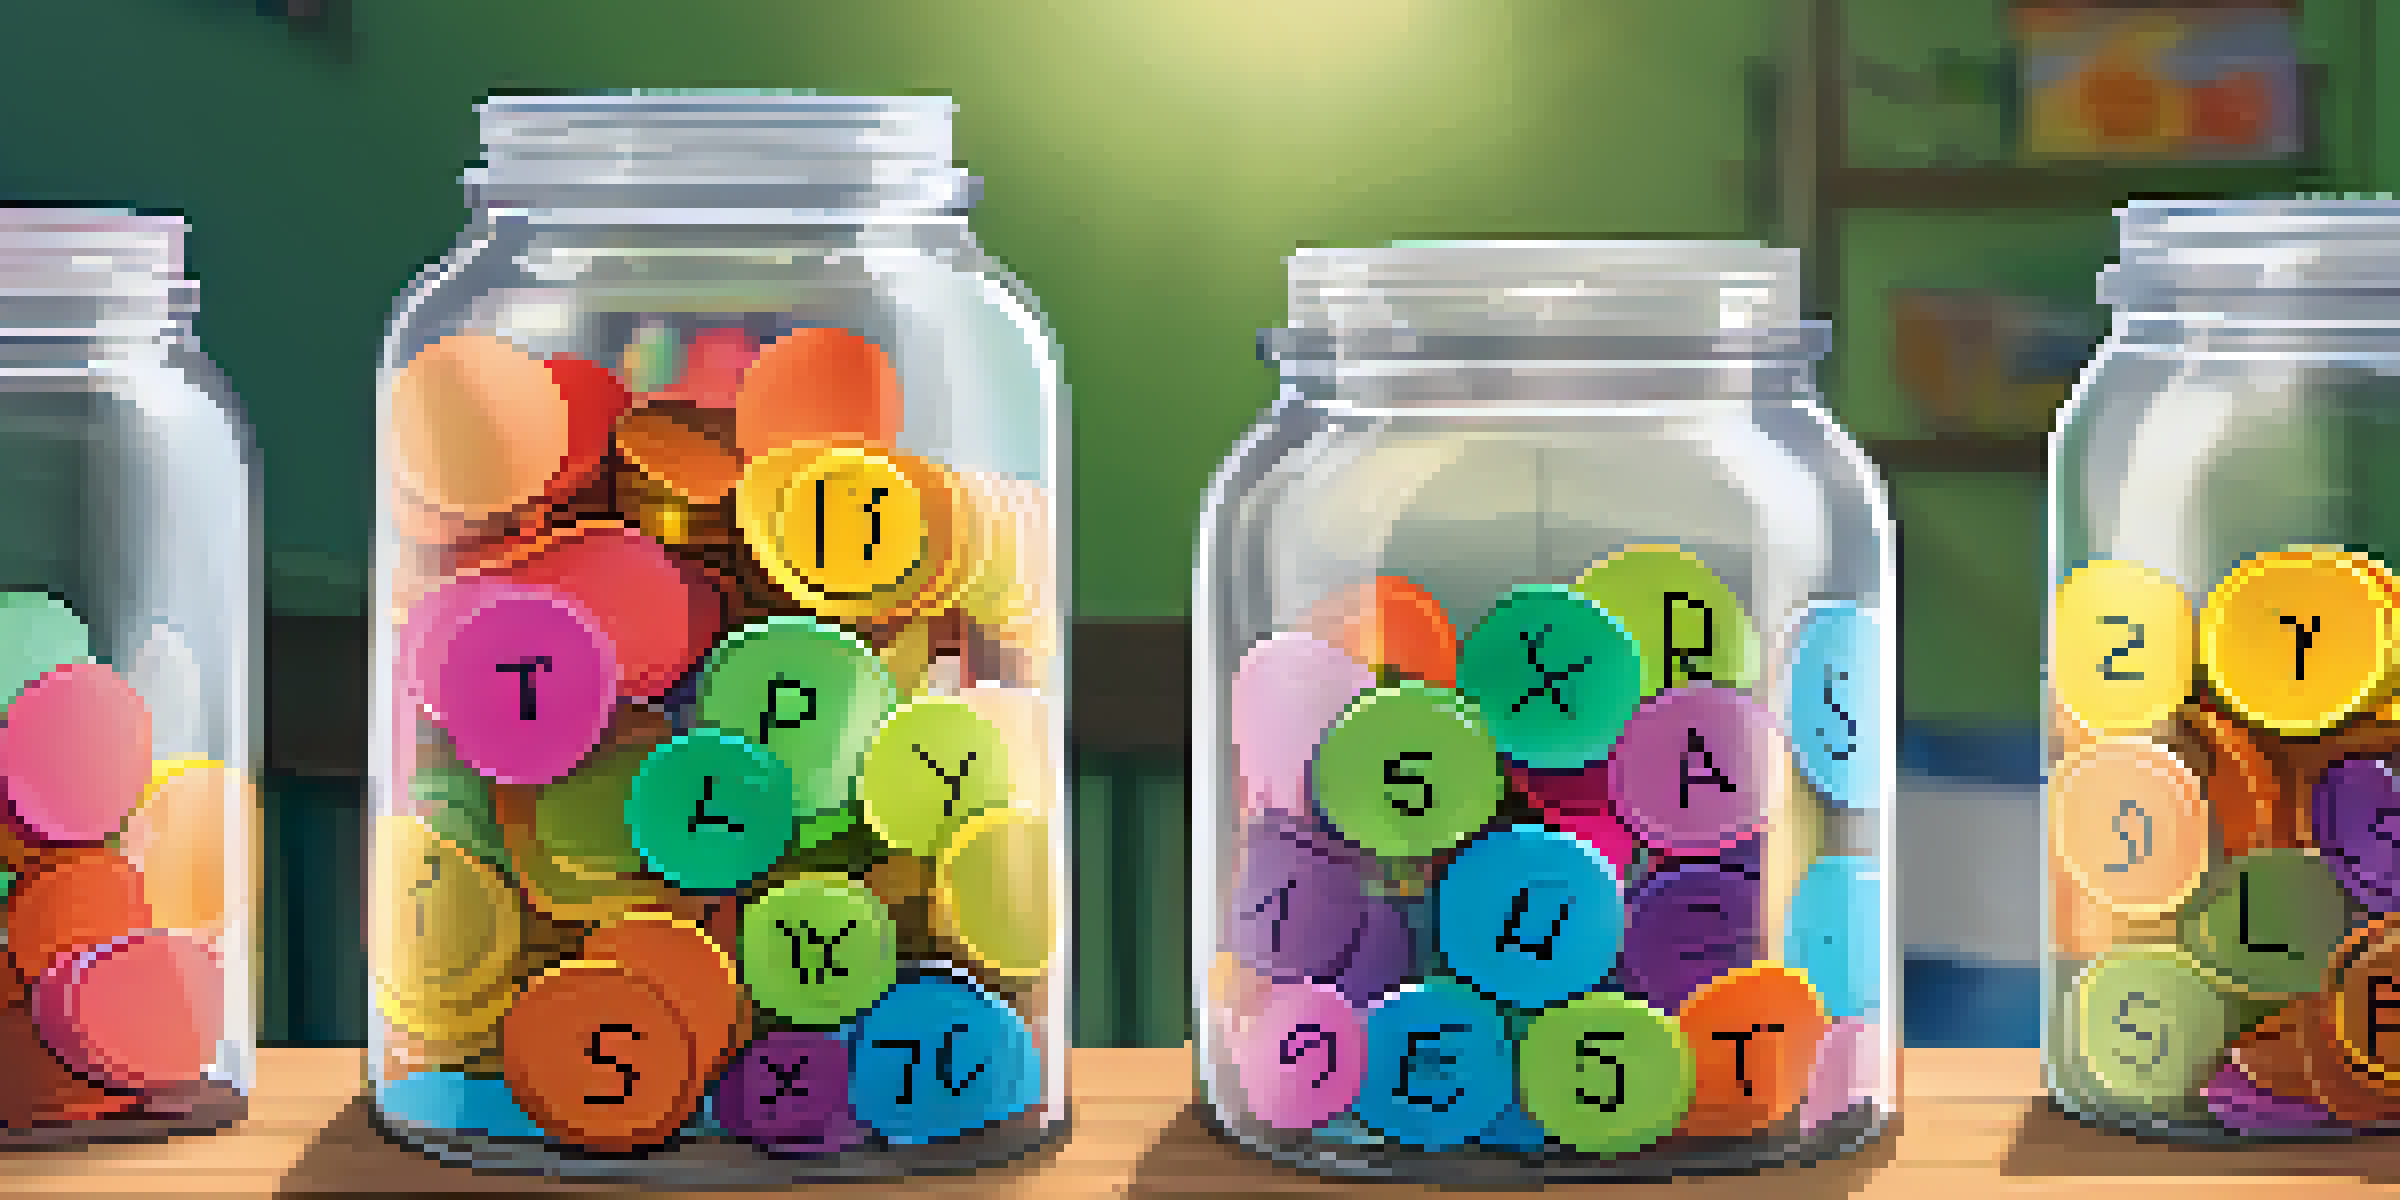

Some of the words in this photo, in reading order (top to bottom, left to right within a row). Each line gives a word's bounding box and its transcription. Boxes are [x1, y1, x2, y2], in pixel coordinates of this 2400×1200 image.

[496, 656, 553, 720] T
[912, 744, 977, 816] Y
[1680, 728, 1737, 808] A
[2240, 872, 2305, 960] L
[1392, 1024, 1473, 1112] E
